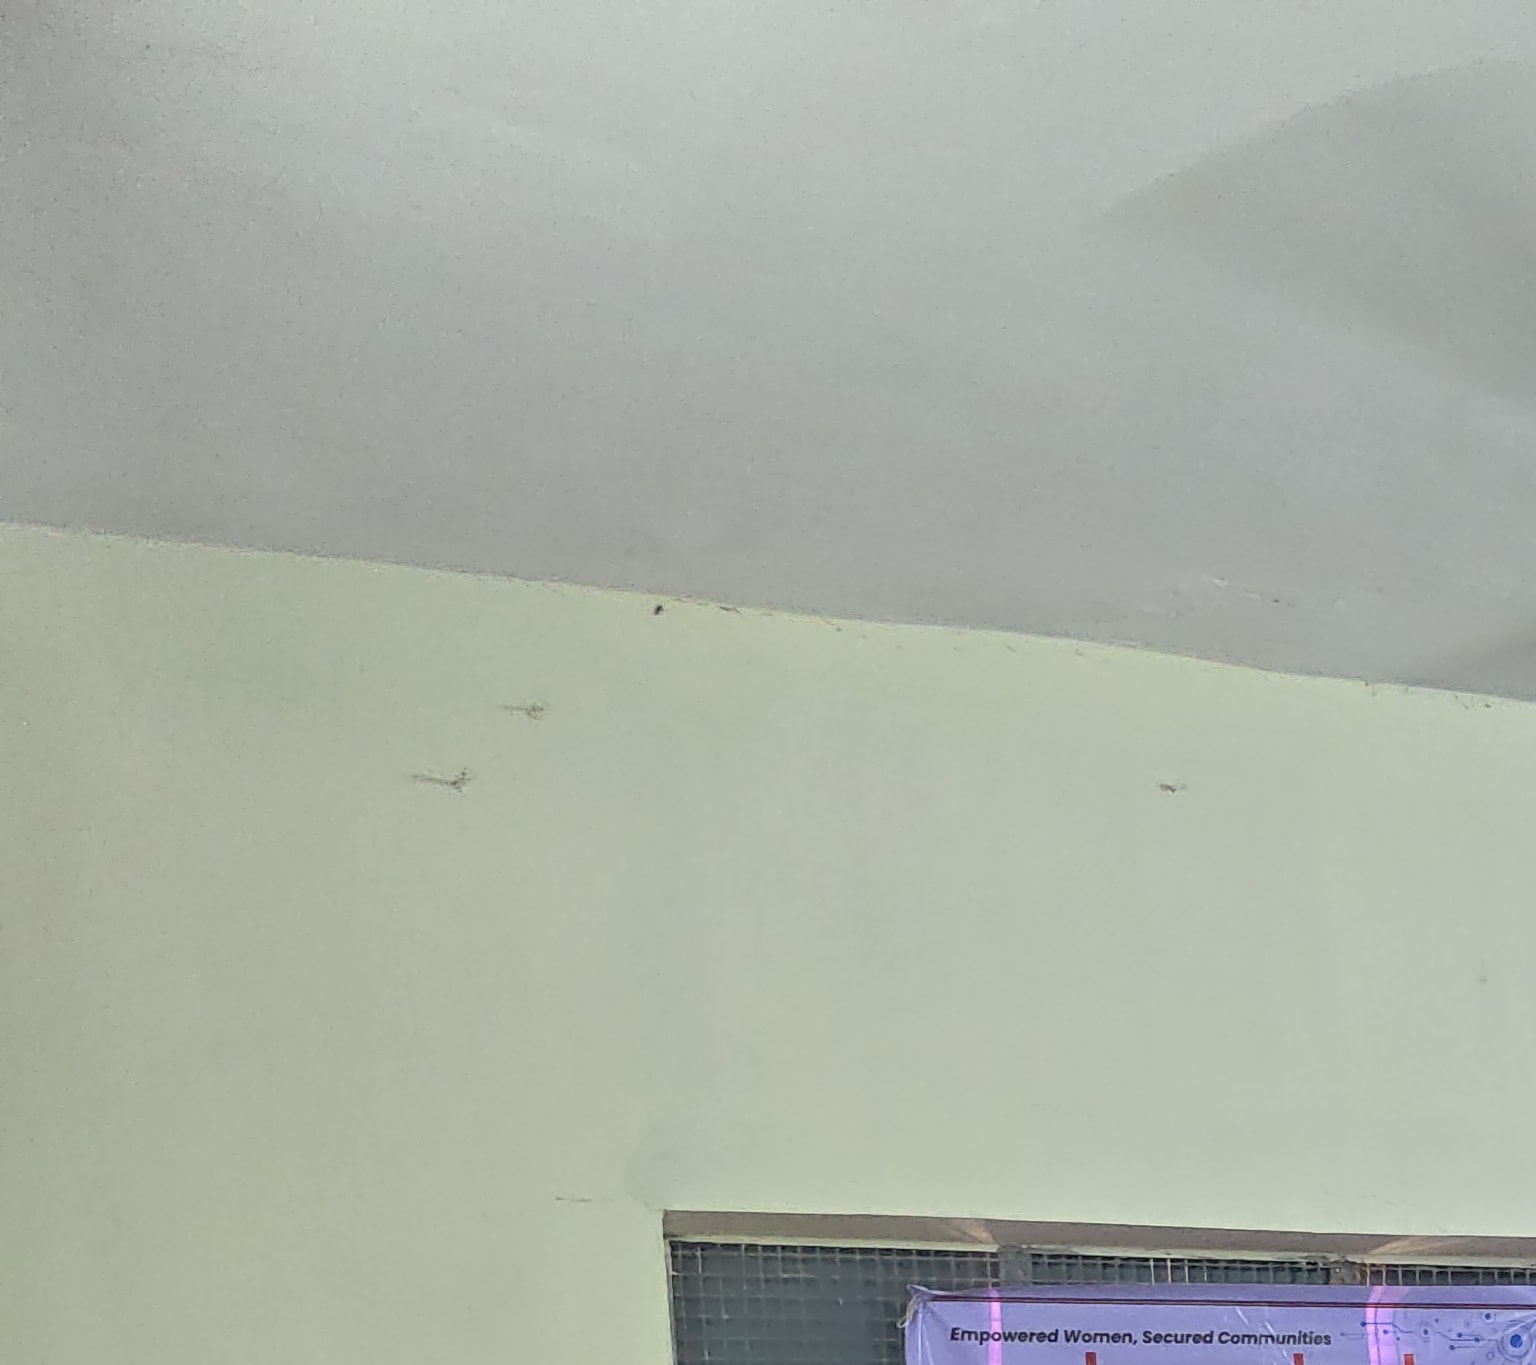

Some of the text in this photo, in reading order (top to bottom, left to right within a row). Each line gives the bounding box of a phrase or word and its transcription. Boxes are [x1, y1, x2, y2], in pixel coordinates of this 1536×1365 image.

[950, 1326, 1332, 1346] Empowered Women, Secured Communities
